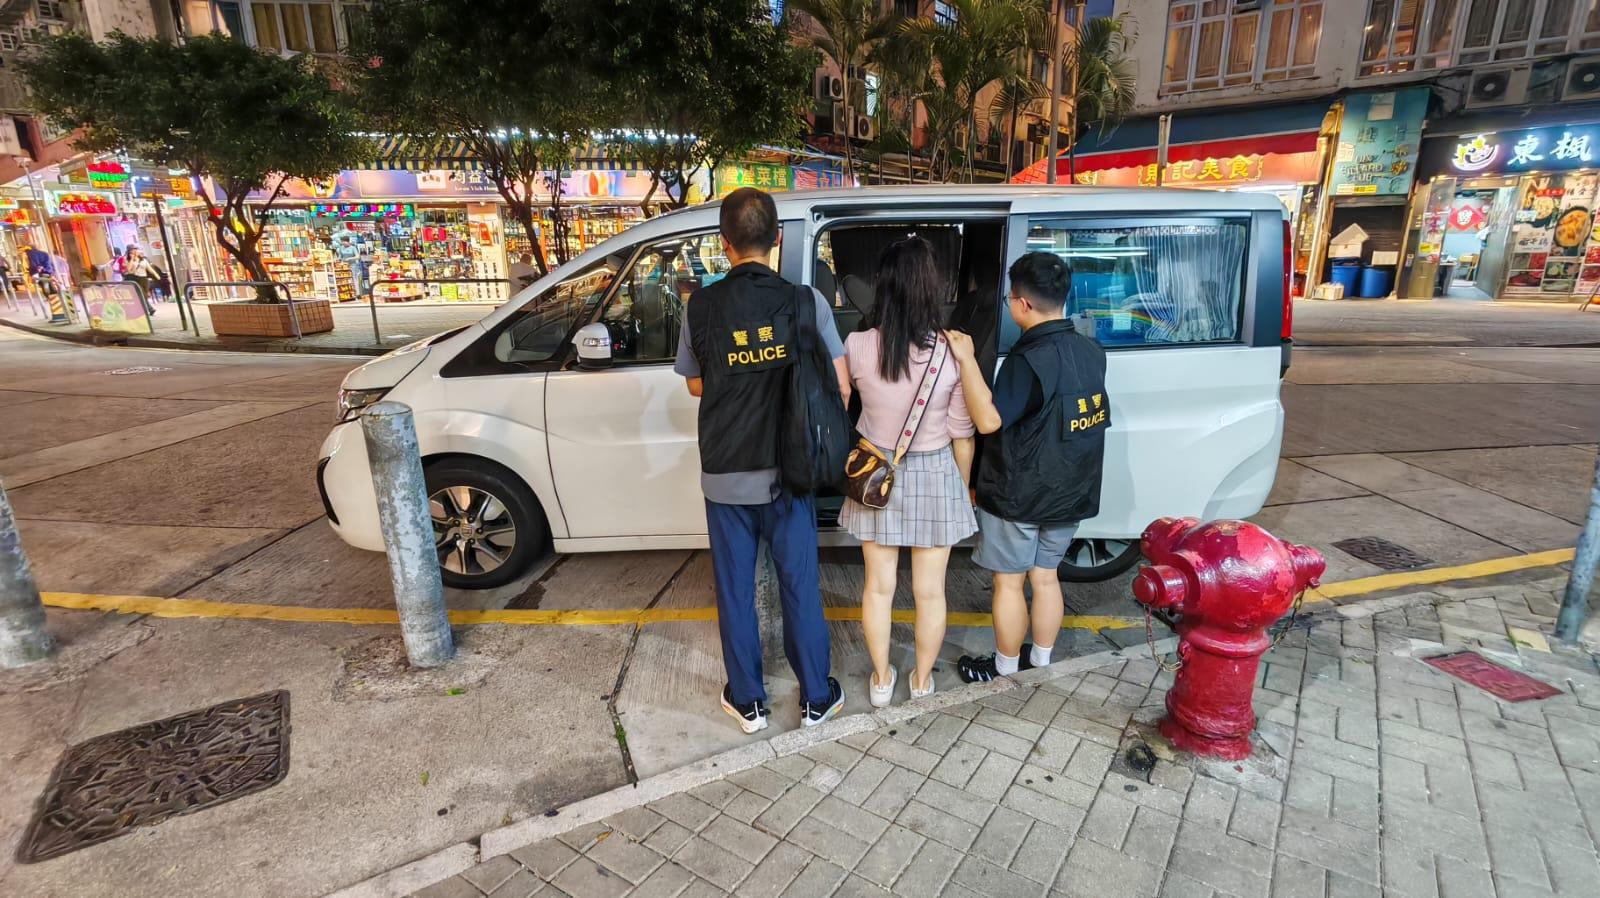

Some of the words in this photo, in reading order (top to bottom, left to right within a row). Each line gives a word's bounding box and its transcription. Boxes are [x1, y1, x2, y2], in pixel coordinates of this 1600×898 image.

[732, 326, 774, 346] 警察
[727, 344, 787, 366] POLICE
[1070, 409, 1105, 433] POLICE
